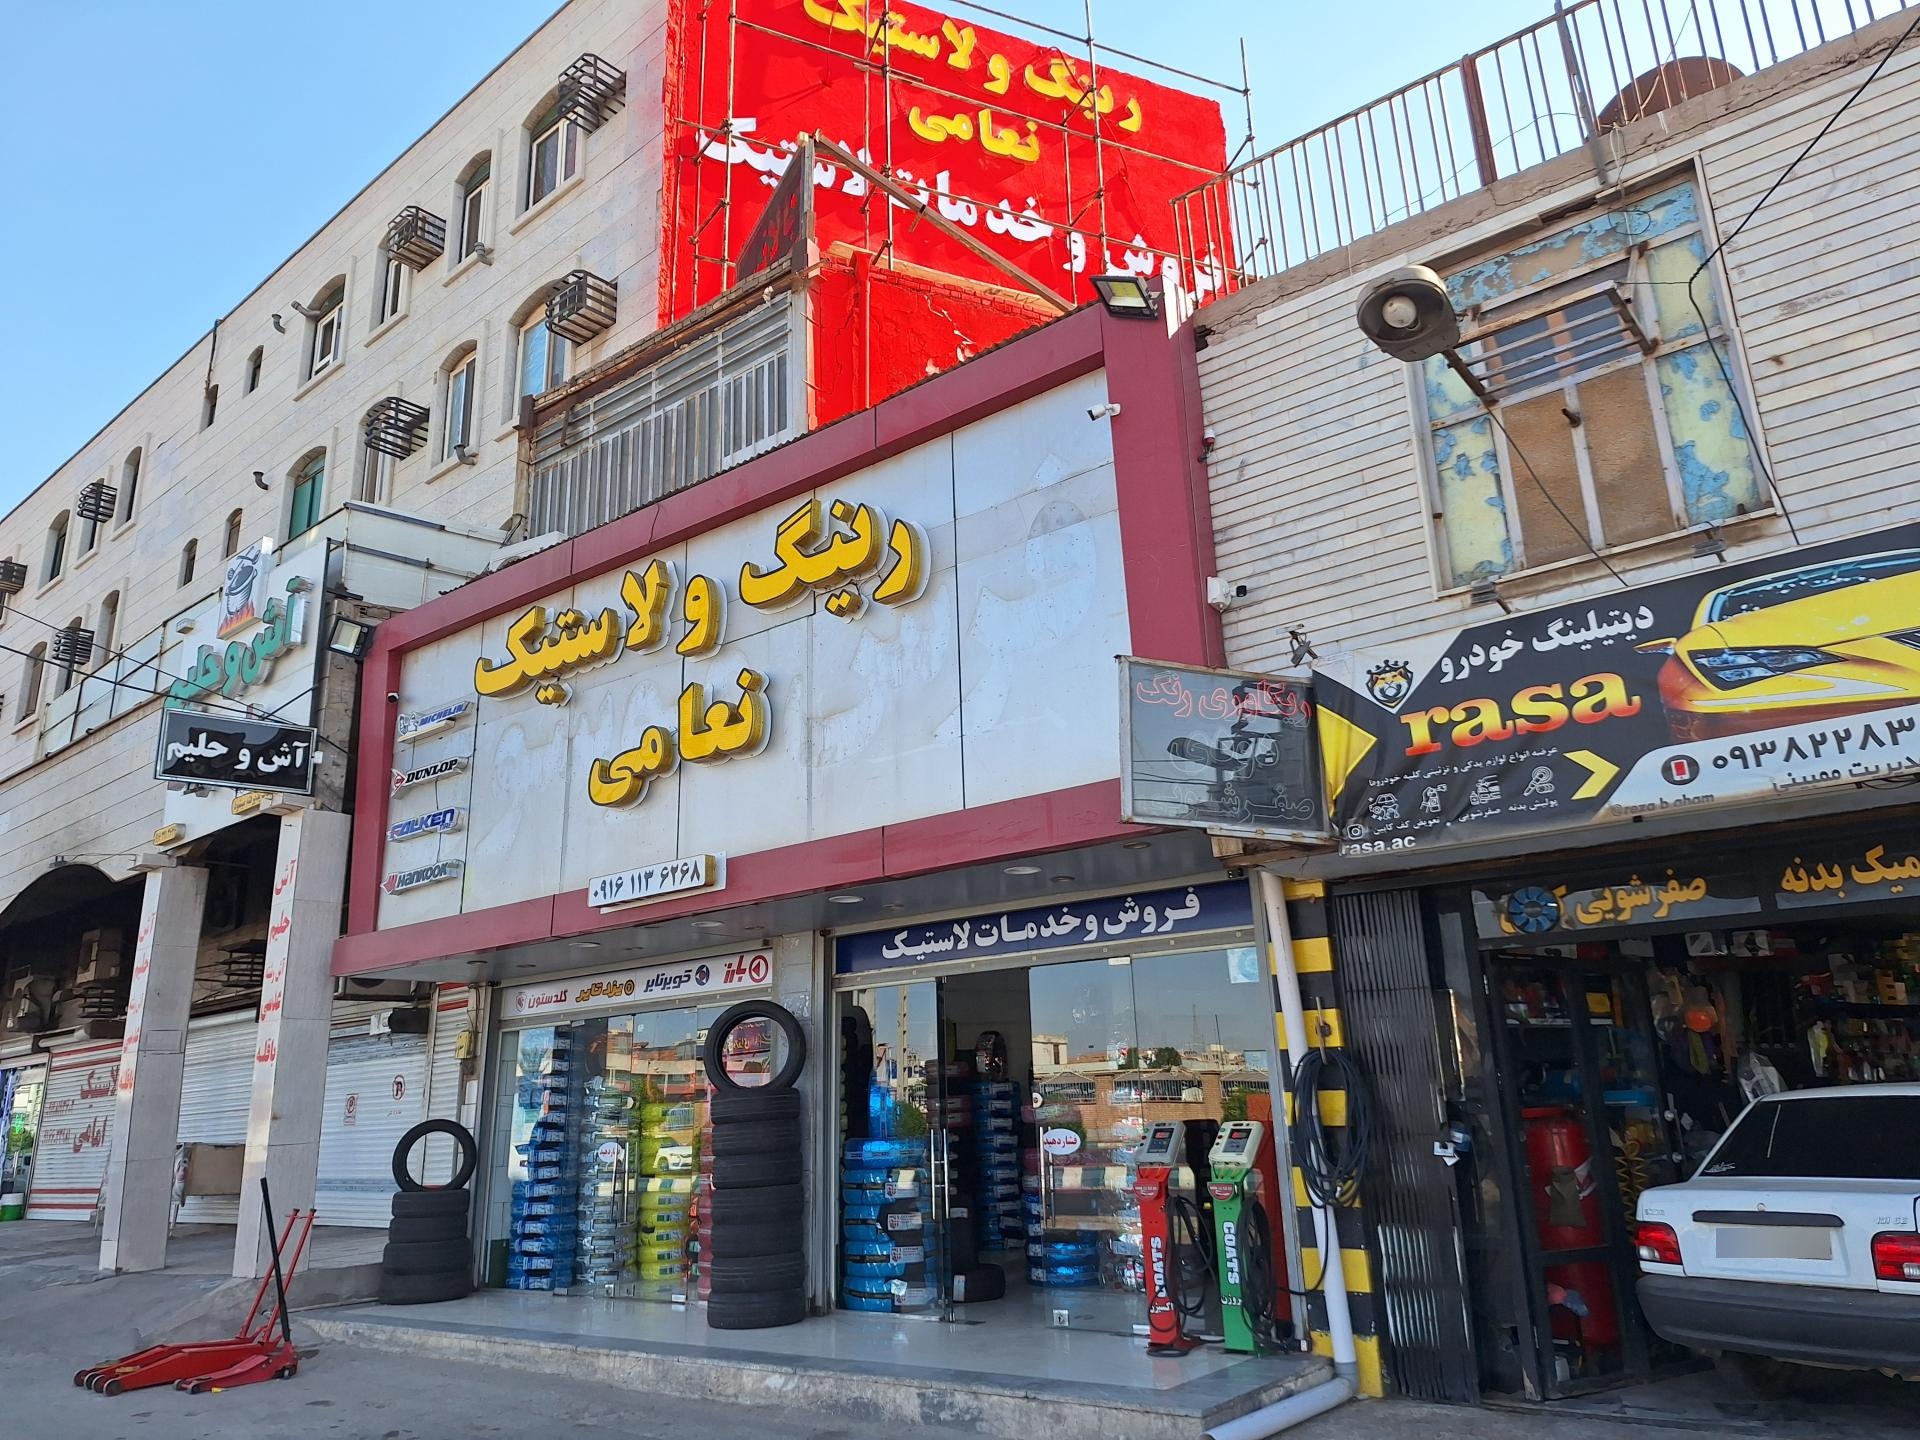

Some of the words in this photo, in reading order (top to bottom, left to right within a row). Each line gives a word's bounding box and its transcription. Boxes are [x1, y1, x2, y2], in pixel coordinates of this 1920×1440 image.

[984, 53, 1010, 95] و
[1024, 57, 1143, 133] رینگ
[909, 106, 1041, 163] نعامی
[888, 168, 1055, 243] خدمات
[1063, 231, 1087, 274] و
[738, 497, 925, 618] رینگ
[475, 558, 670, 707] لاستیک
[676, 574, 724, 658] و
[1531, 604, 1655, 652] دیتیلینگ
[222, 641, 248, 700] و
[1439, 627, 1524, 684] خودرو
[419, 703, 466, 727] MICHELIN
[1400, 671, 1642, 757] rasa
[167, 732, 229, 764] حلیم
[257, 740, 308, 772] آش
[588, 667, 767, 808] نعامی
[1508, 749, 1530, 765] انواع
[1532, 746, 1559, 758] عرضه
[234, 748, 251, 770] و
[405, 758, 458, 784] DUNLOP
[1403, 770, 1421, 782] کلیه
[1452, 765, 1459, 774] و
[1460, 760, 1483, 774] یدکی
[1485, 755, 1507, 769] لوازم
[391, 808, 456, 838] FALKEN
[1398, 820, 1410, 830] کف
[1412, 817, 1441, 831] تعویض
[1508, 802, 1528, 812] بدنه
[1341, 835, 1417, 857] rasa.ac
[1780, 856, 1845, 899] بدنه
[974, 906, 1082, 948] خدمات
[1082, 912, 1100, 942] و
[1103, 886, 1201, 936] فروش
[881, 920, 972, 961] لاستیک
[723, 954, 747, 985] بارز
[1150, 1235, 1167, 1298] COATS
[1221, 1221, 1240, 1285] COATS
